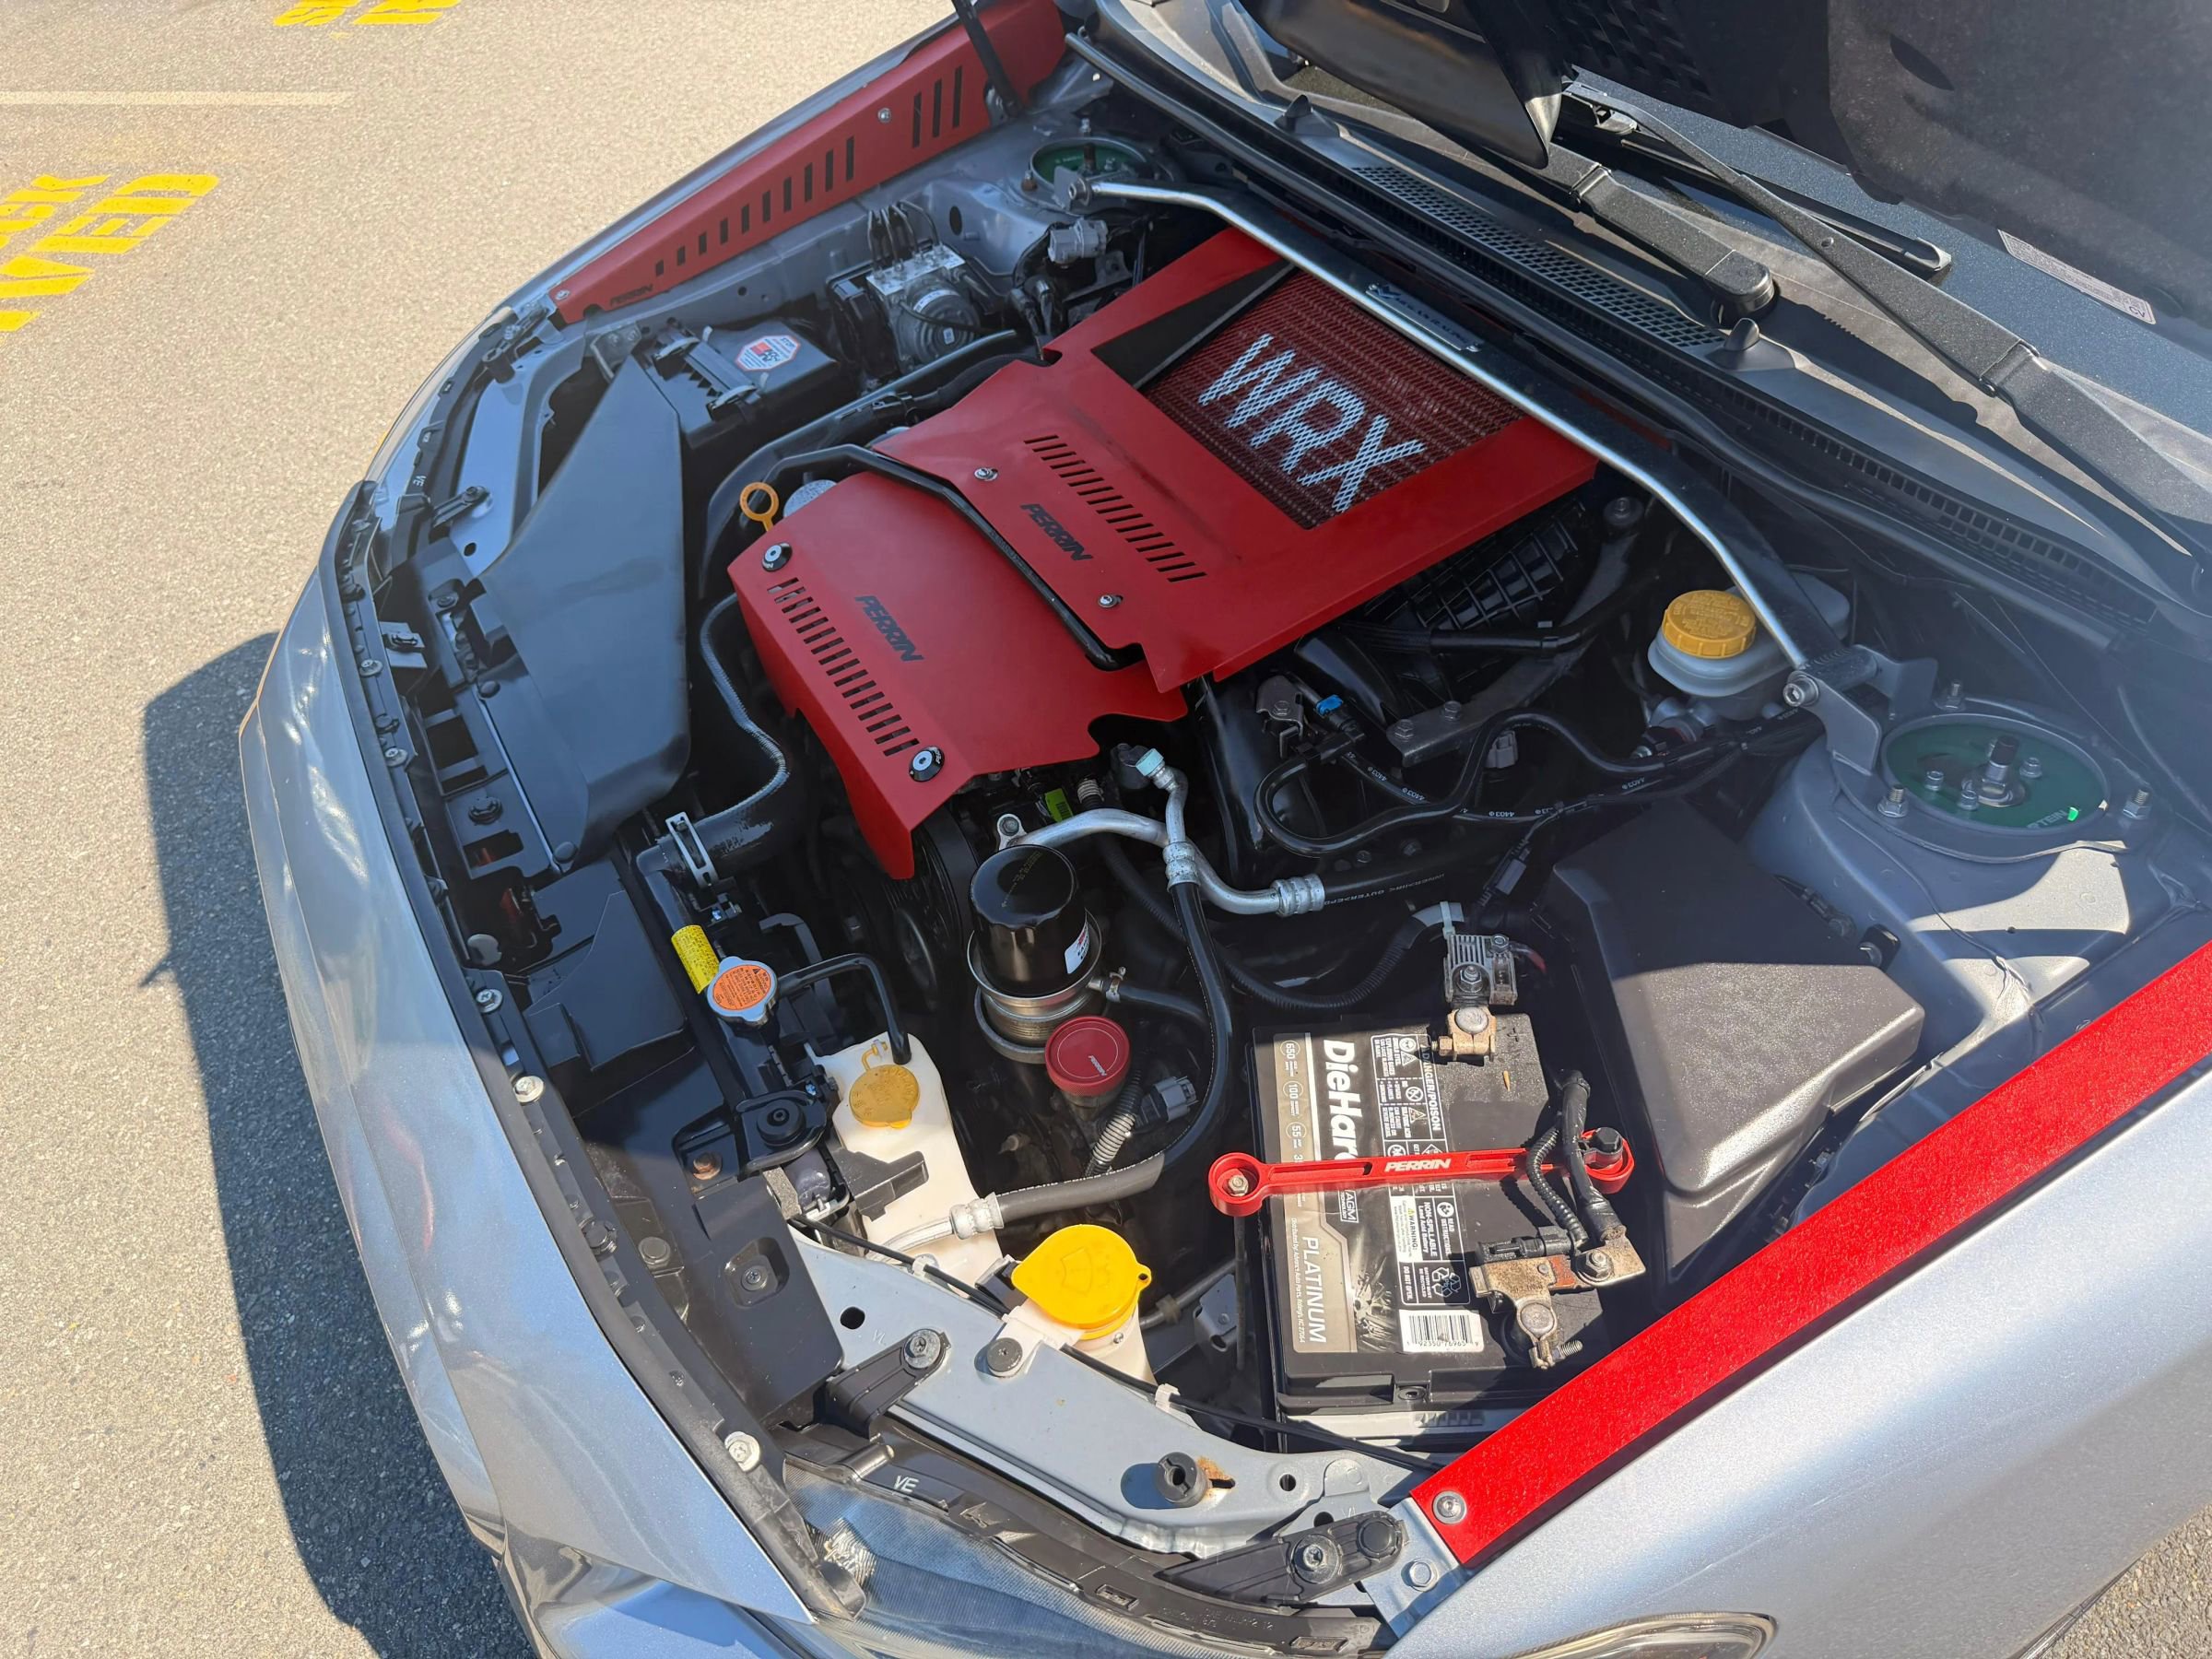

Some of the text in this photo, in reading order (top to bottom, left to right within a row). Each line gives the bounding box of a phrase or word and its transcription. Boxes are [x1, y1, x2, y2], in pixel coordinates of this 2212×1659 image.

[1197, 333, 1428, 512] WRX
[1019, 503, 1094, 561] PERRIN
[853, 594, 925, 662] PERRIN
[1286, 1042, 1295, 1059] 650
[1288, 1083, 1298, 1100] 100
[1384, 1159, 1452, 1172] PERRIN
[1345, 1192, 1356, 1221] AGM
[1408, 1216, 1418, 1251] WARNING:
[1423, 1201, 1438, 1257] NON-SPILLABLE
[1302, 1237, 1327, 1344] PLATINUM
[893, 1475, 920, 1493] VE
